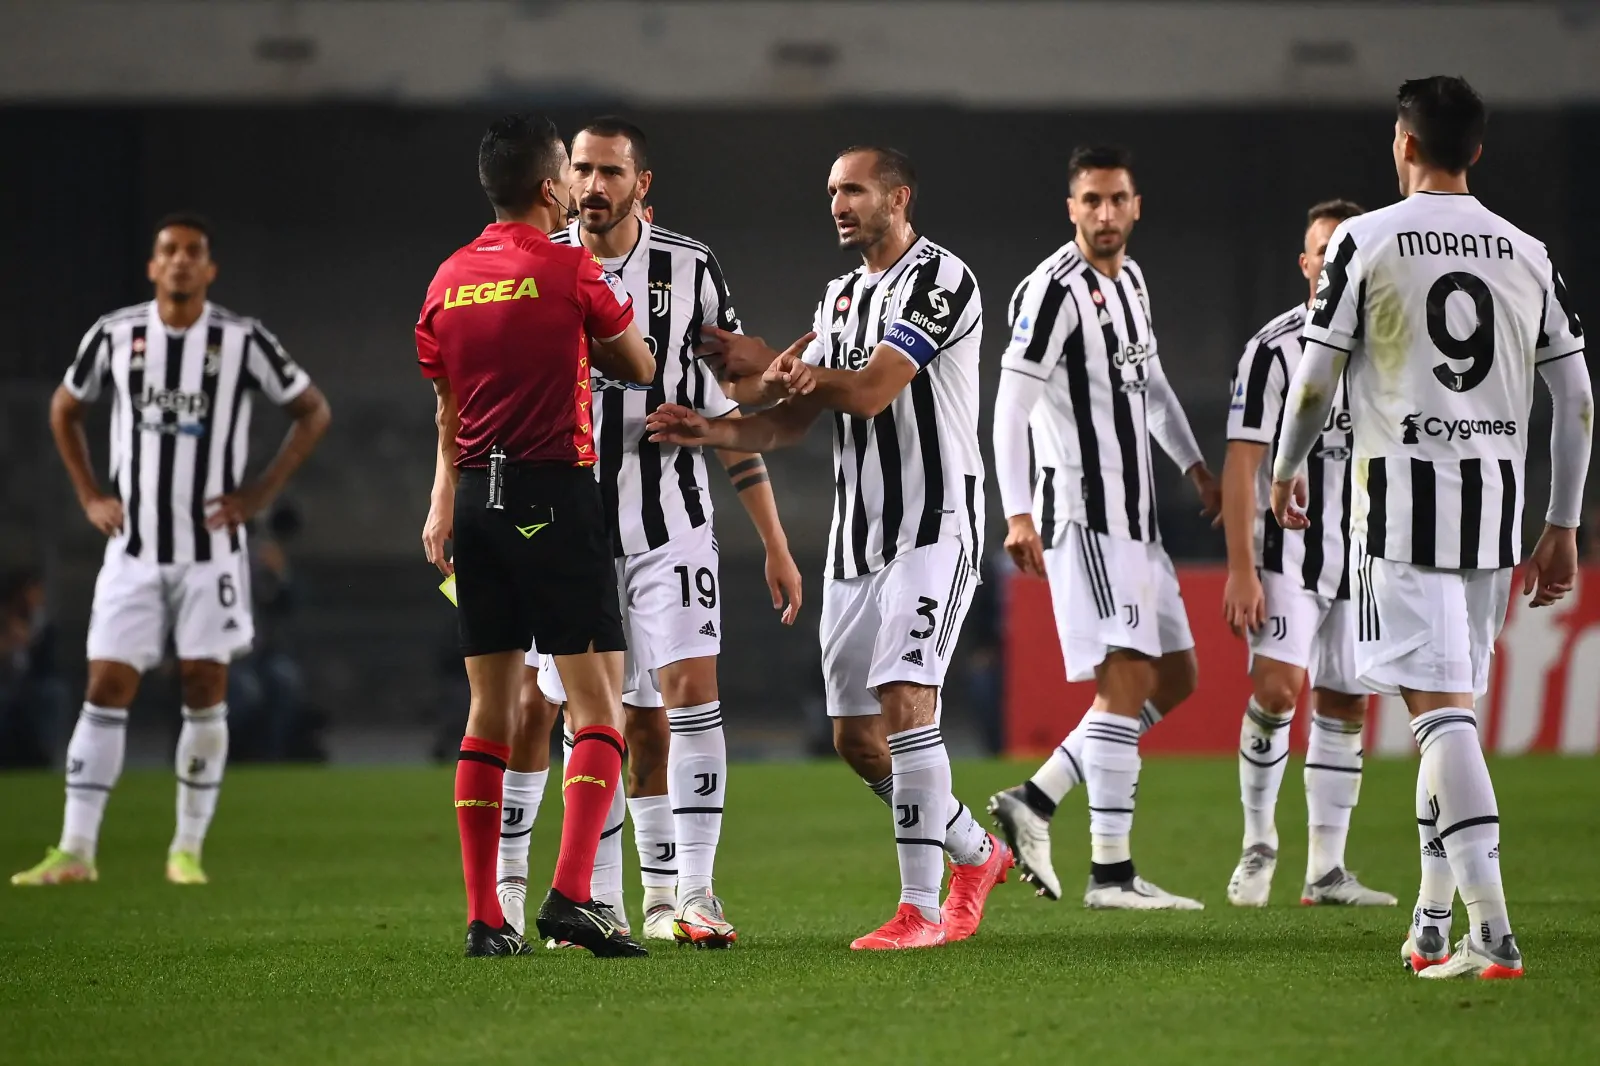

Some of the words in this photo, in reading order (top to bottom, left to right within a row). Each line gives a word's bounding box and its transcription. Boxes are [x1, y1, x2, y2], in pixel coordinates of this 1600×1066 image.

[1397, 231, 1514, 260] MORATA
[444, 278, 539, 310] LEGEA
[1426, 271, 1495, 393] 9
[1424, 417, 1517, 441] Cygames
[217, 573, 236, 607] 6
[674, 565, 716, 609] 19
[909, 595, 939, 639] 3
[454, 799, 499, 809] LEGEA
